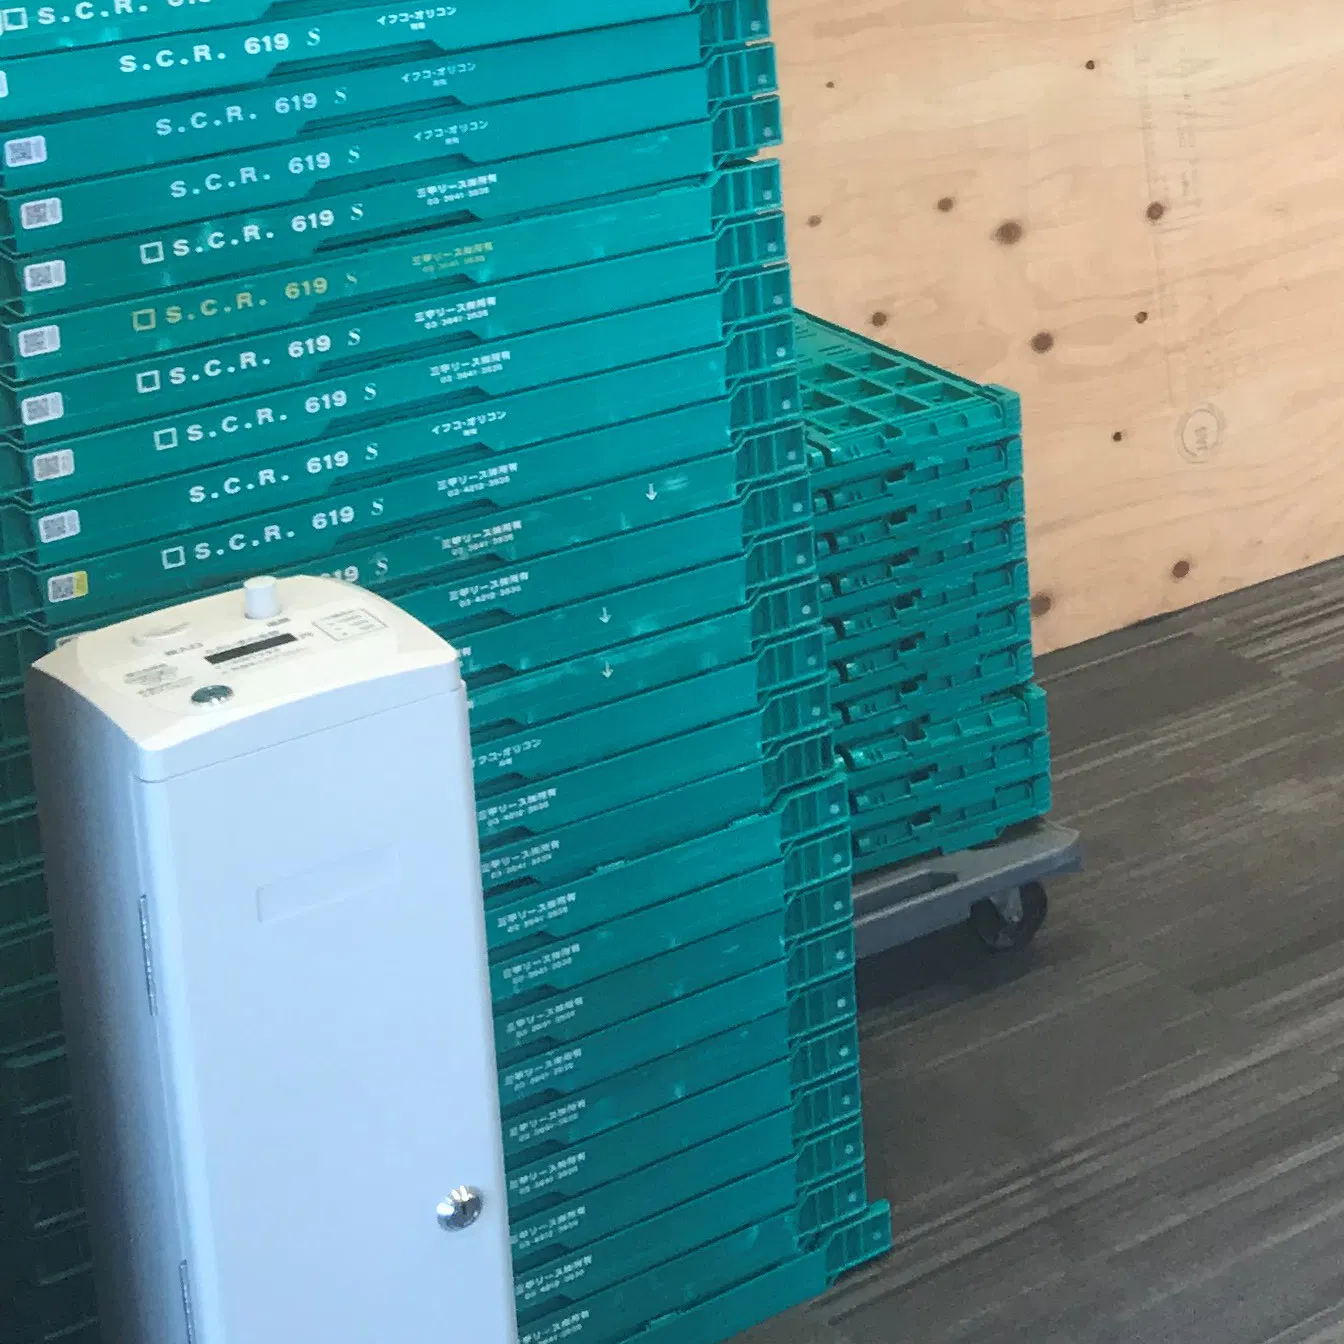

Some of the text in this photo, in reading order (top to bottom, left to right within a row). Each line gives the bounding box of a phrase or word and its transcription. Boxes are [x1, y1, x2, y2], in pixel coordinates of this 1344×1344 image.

[243, 32, 291, 56] 619
[274, 91, 318, 115] 619
[288, 151, 332, 176] 619
[291, 209, 336, 234] 619
[283, 276, 329, 301] 619
[288, 334, 332, 359] 619
[304, 389, 349, 415] 619
[305, 450, 350, 475] 619
[311, 505, 356, 531] 619
